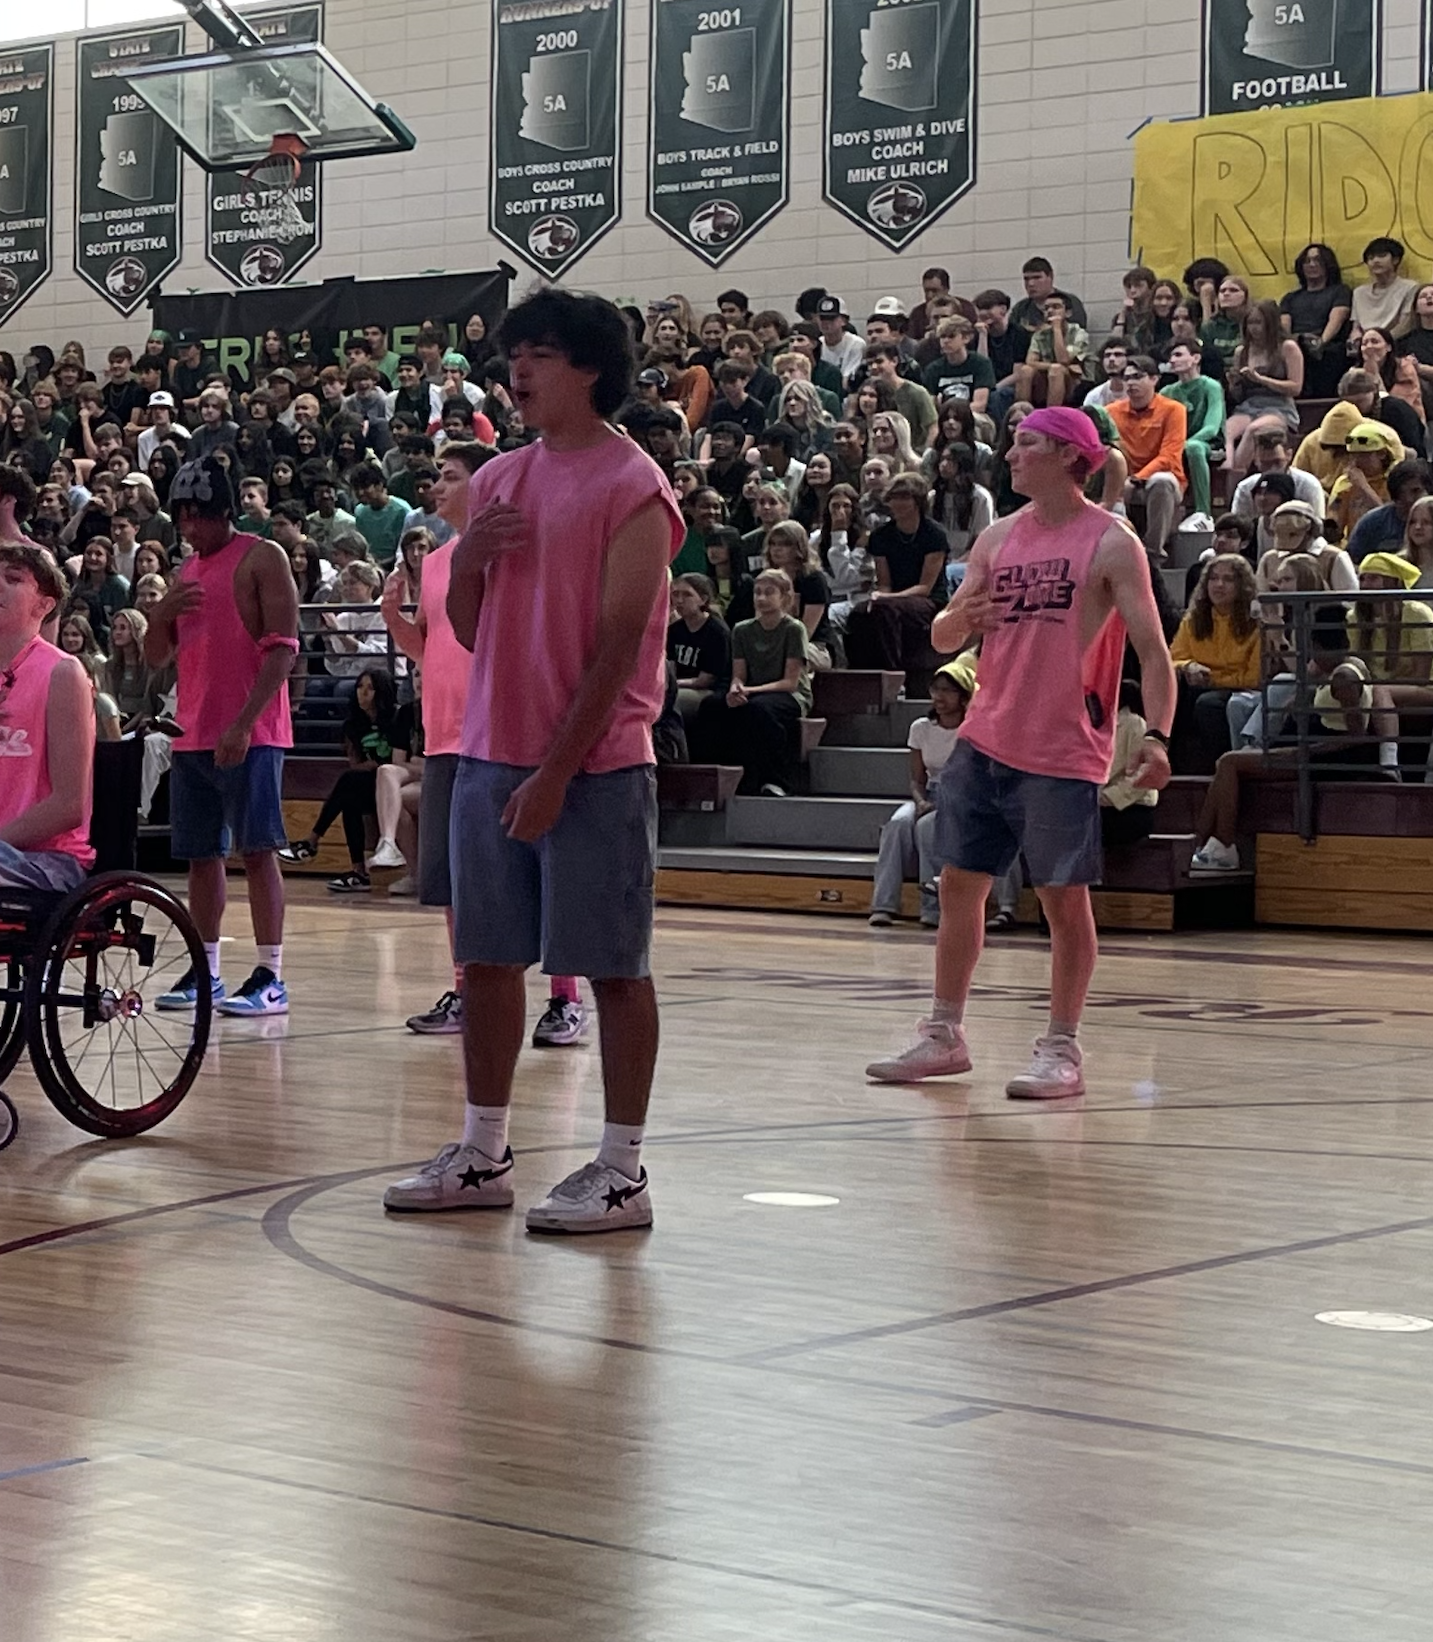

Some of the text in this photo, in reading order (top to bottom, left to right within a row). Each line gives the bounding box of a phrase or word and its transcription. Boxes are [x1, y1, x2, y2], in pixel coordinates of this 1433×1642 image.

[697, 8, 741, 31] 2001
[1274, 3, 1305, 25] 5A
[536, 30, 578, 51] 2000
[886, 51, 912, 71] 5A
[706, 74, 730, 93] 5A
[1232, 70, 1347, 100] FOOTBALL
[544, 95, 566, 112] 5A
[832, 118, 965, 146] BOYS SWIM & DIVE
[118, 150, 137, 167] 5A
[657, 141, 778, 165] BOYS TRACK & FIELD
[871, 141, 924, 160] COACH
[498, 156, 613, 178] BOYS CROSS COUNTRY
[701, 166, 733, 177] COACH
[847, 159, 948, 183] MIKE ULRICH
[532, 178, 575, 193] COACH
[213, 186, 313, 211] GIRLS TENIS
[505, 193, 605, 215] SCOTT PESTKA
[104, 208, 133, 220] CROSS
[134, 204, 176, 217] COUNTRY
[6, 217, 46, 231] COUNTRY
[107, 222, 145, 236] COACH
[86, 236, 167, 256] SCOTT PESTKA
